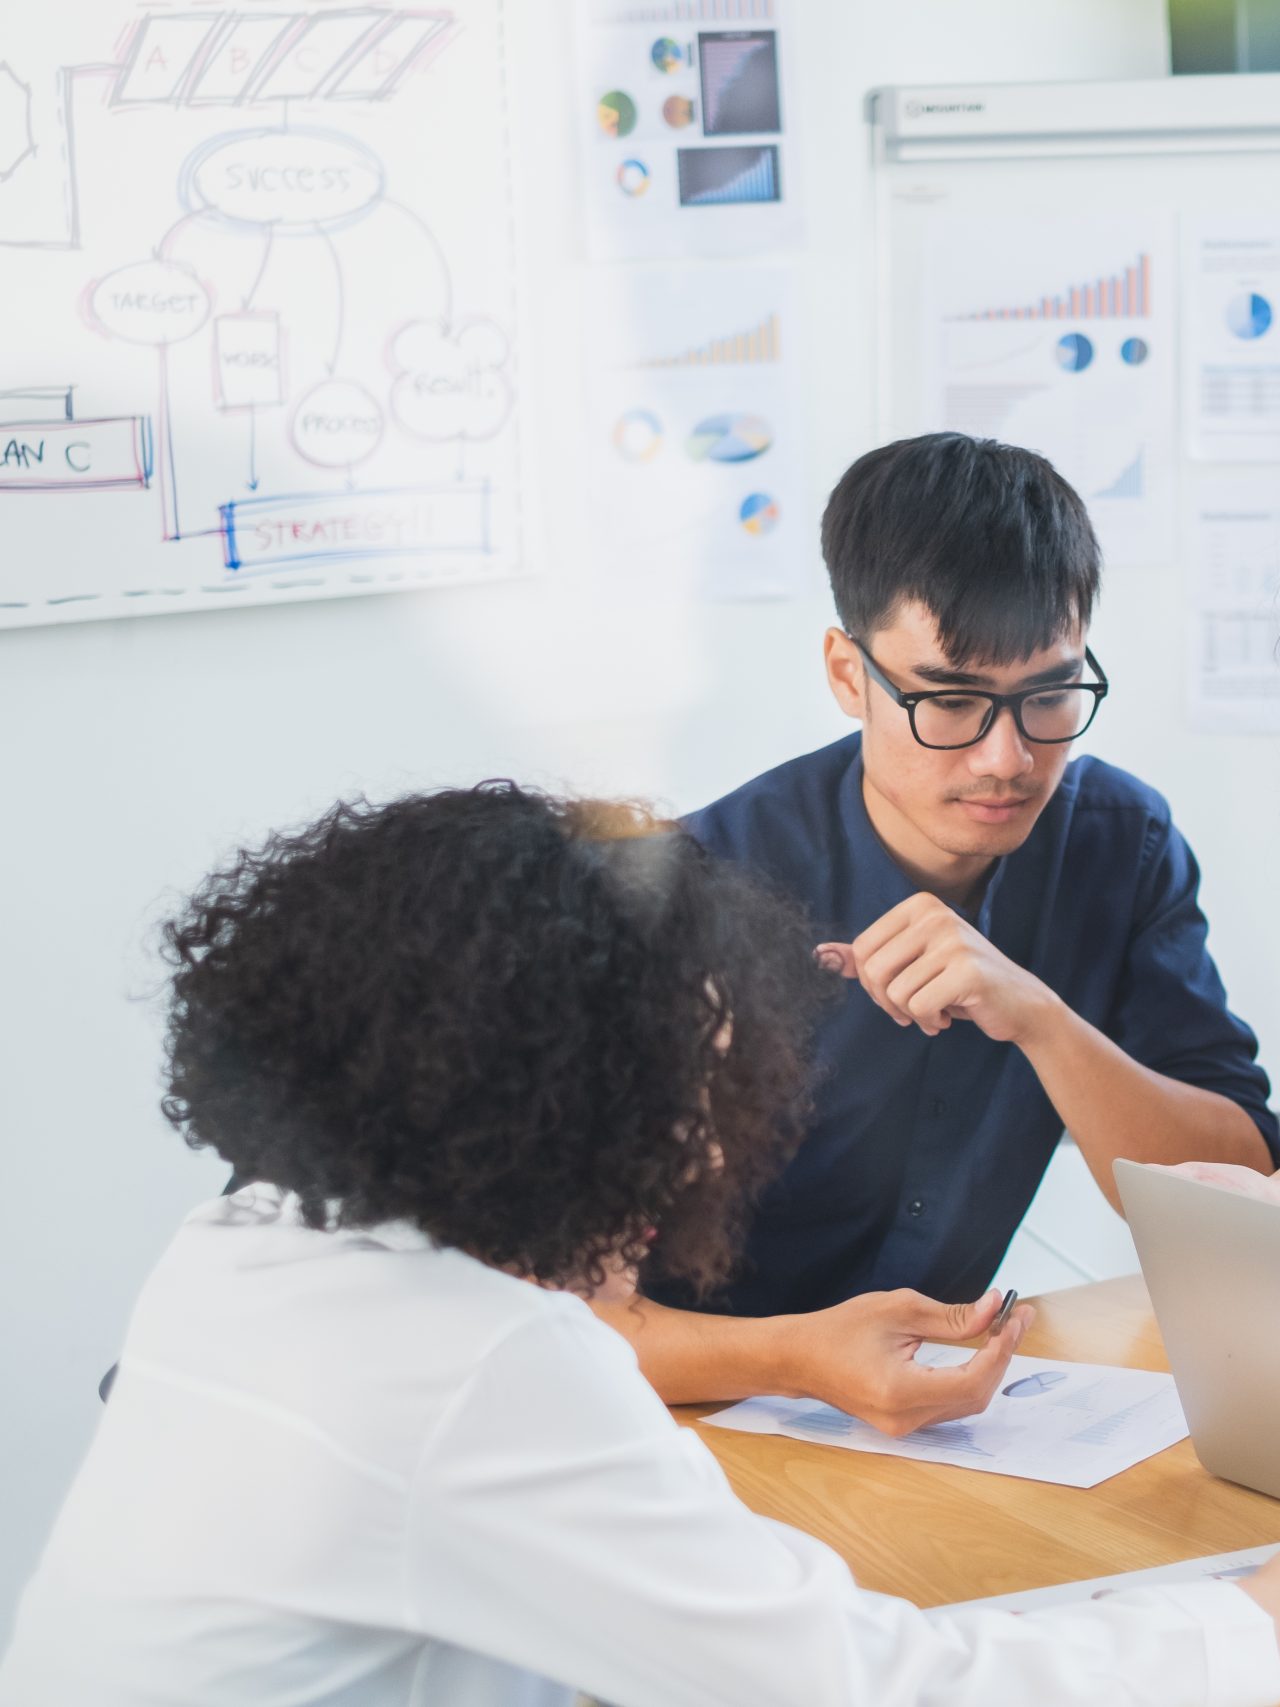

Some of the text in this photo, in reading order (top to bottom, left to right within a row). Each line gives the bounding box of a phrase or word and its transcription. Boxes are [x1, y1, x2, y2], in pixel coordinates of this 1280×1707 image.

[144, 45, 168, 74] A
[229, 46, 251, 75] B
[109, 292, 199, 314] TARGET
[65, 441, 91, 473] C
